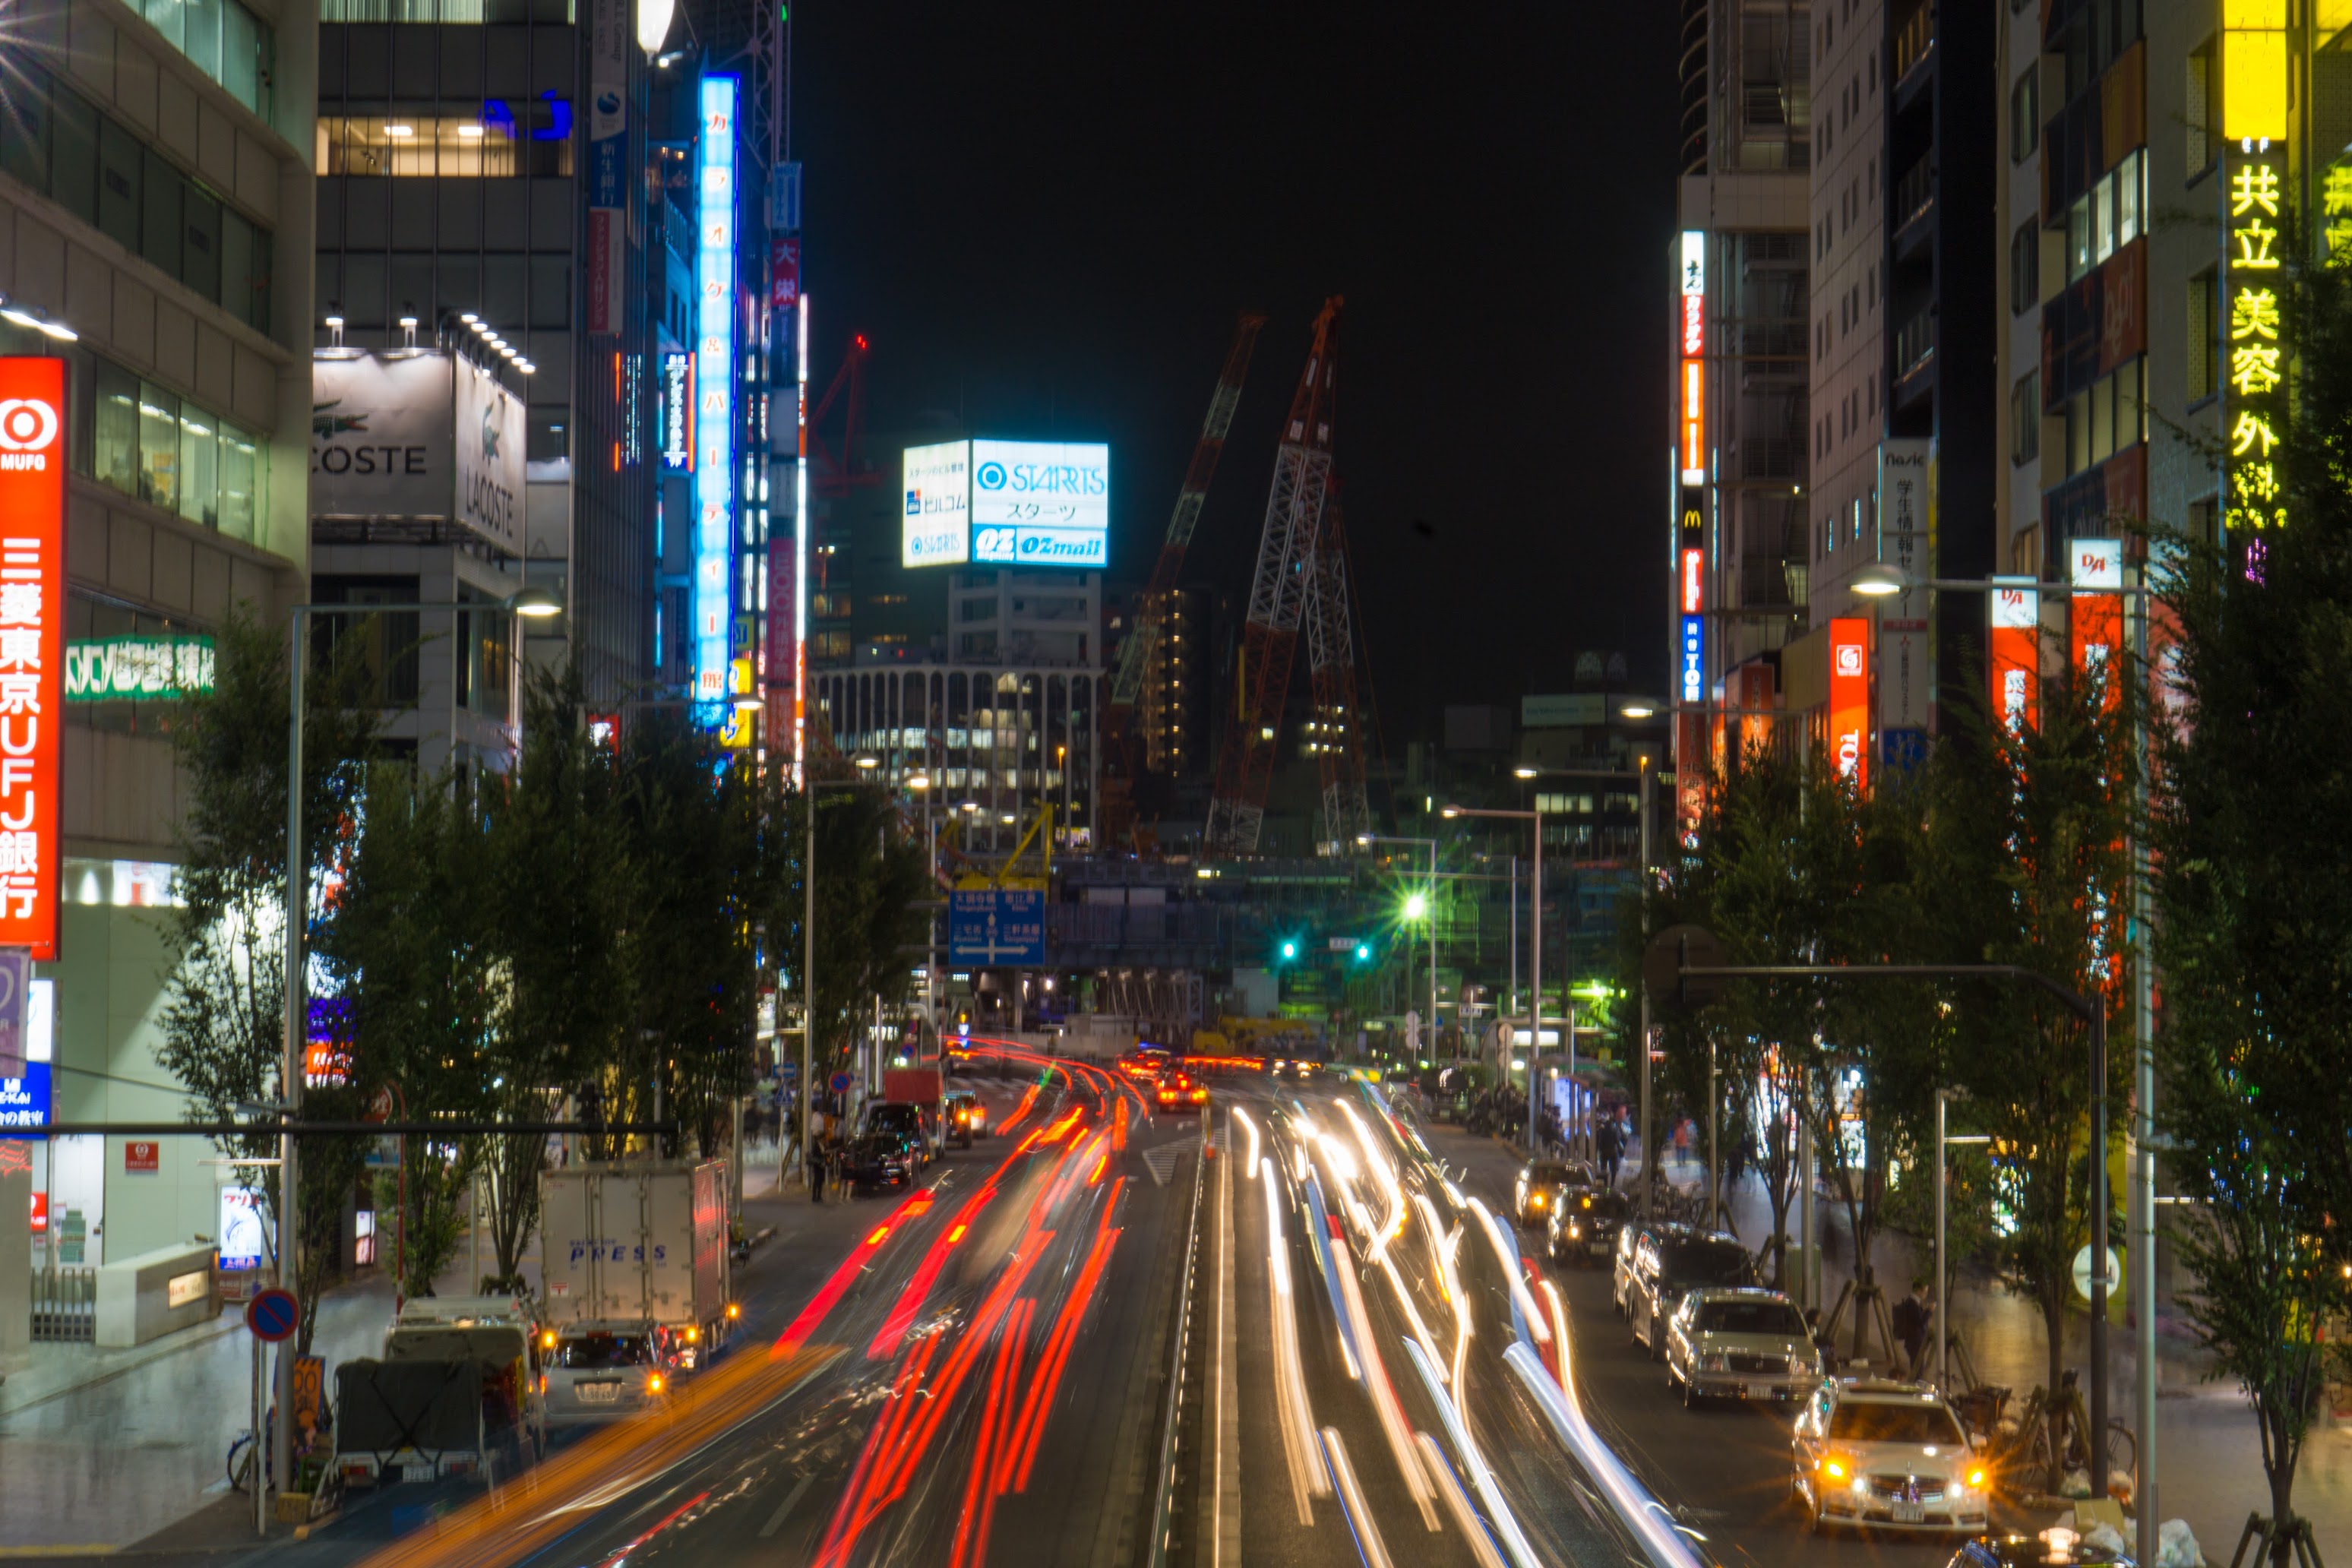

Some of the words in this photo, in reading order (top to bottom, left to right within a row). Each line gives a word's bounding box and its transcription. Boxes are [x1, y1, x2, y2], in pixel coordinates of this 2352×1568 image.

[775, 242, 796, 301] 大栄
[1686, 295, 1702, 355] カラオケ
[1, 454, 46, 470] MUFG
[312, 444, 427, 475] OSTE
[1011, 464, 1105, 495] STARTS
[466, 464, 514, 537] LACOSTE
[925, 495, 965, 514] ビルコム
[1007, 503, 1076, 522] スターツ
[924, 533, 960, 553] STARTS
[976, 528, 1016, 552] OZ
[1022, 536, 1102, 556] OZmall
[1896, 478, 1914, 617] 学生情報セター
[0, 538, 42, 919] 三菱東京UFJ銀行
[571, 1245, 666, 1263] PRESS
